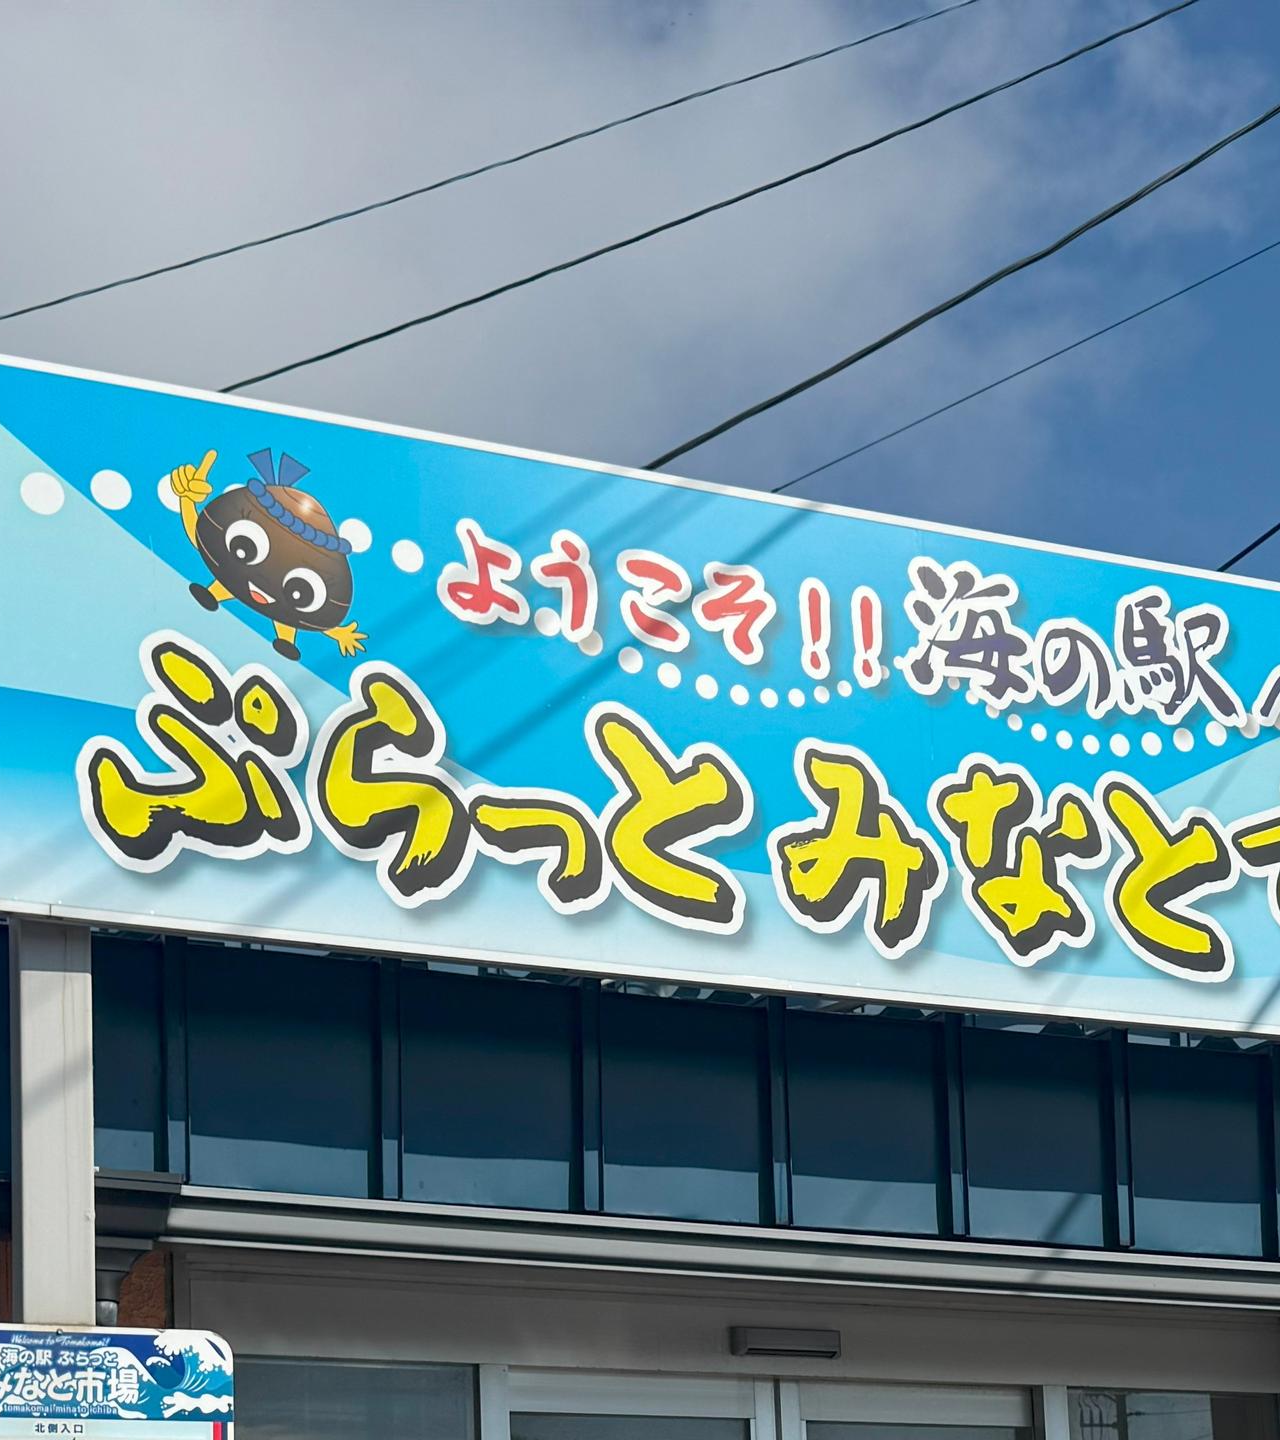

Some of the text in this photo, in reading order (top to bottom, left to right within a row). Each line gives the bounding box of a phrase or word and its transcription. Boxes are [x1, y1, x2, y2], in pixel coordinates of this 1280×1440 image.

[11, 1334, 44, 1345] Welcome
[46, 1335, 55, 1345] to
[1, 1348, 119, 1367] 海の駅 ぷらっと
[3, 1404, 118, 1415] tomakomai minato ichiba
[34, 1423, 84, 1434] 北側入口
